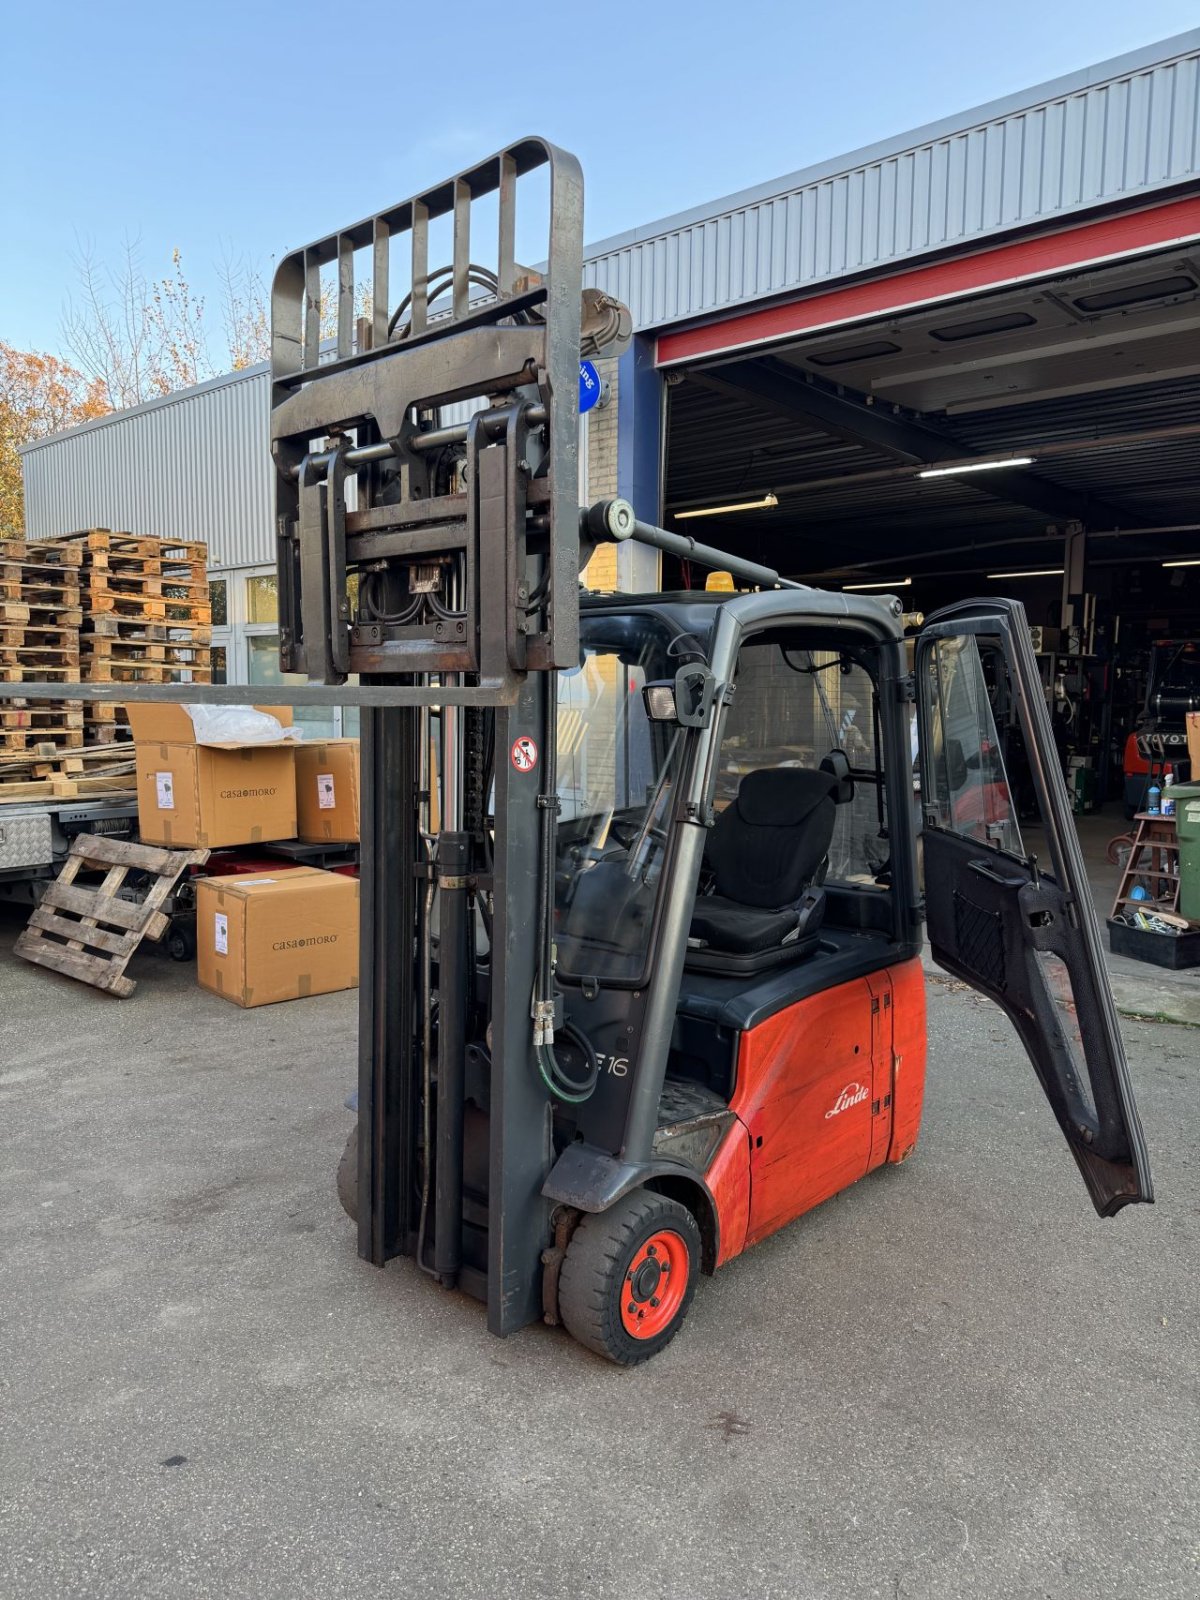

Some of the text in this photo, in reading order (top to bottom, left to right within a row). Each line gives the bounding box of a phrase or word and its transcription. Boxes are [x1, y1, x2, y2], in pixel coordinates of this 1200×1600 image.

[579, 364, 595, 390] ing
[1145, 733, 1188, 744] TOYOT
[824, 1082, 869, 1119] Linde
